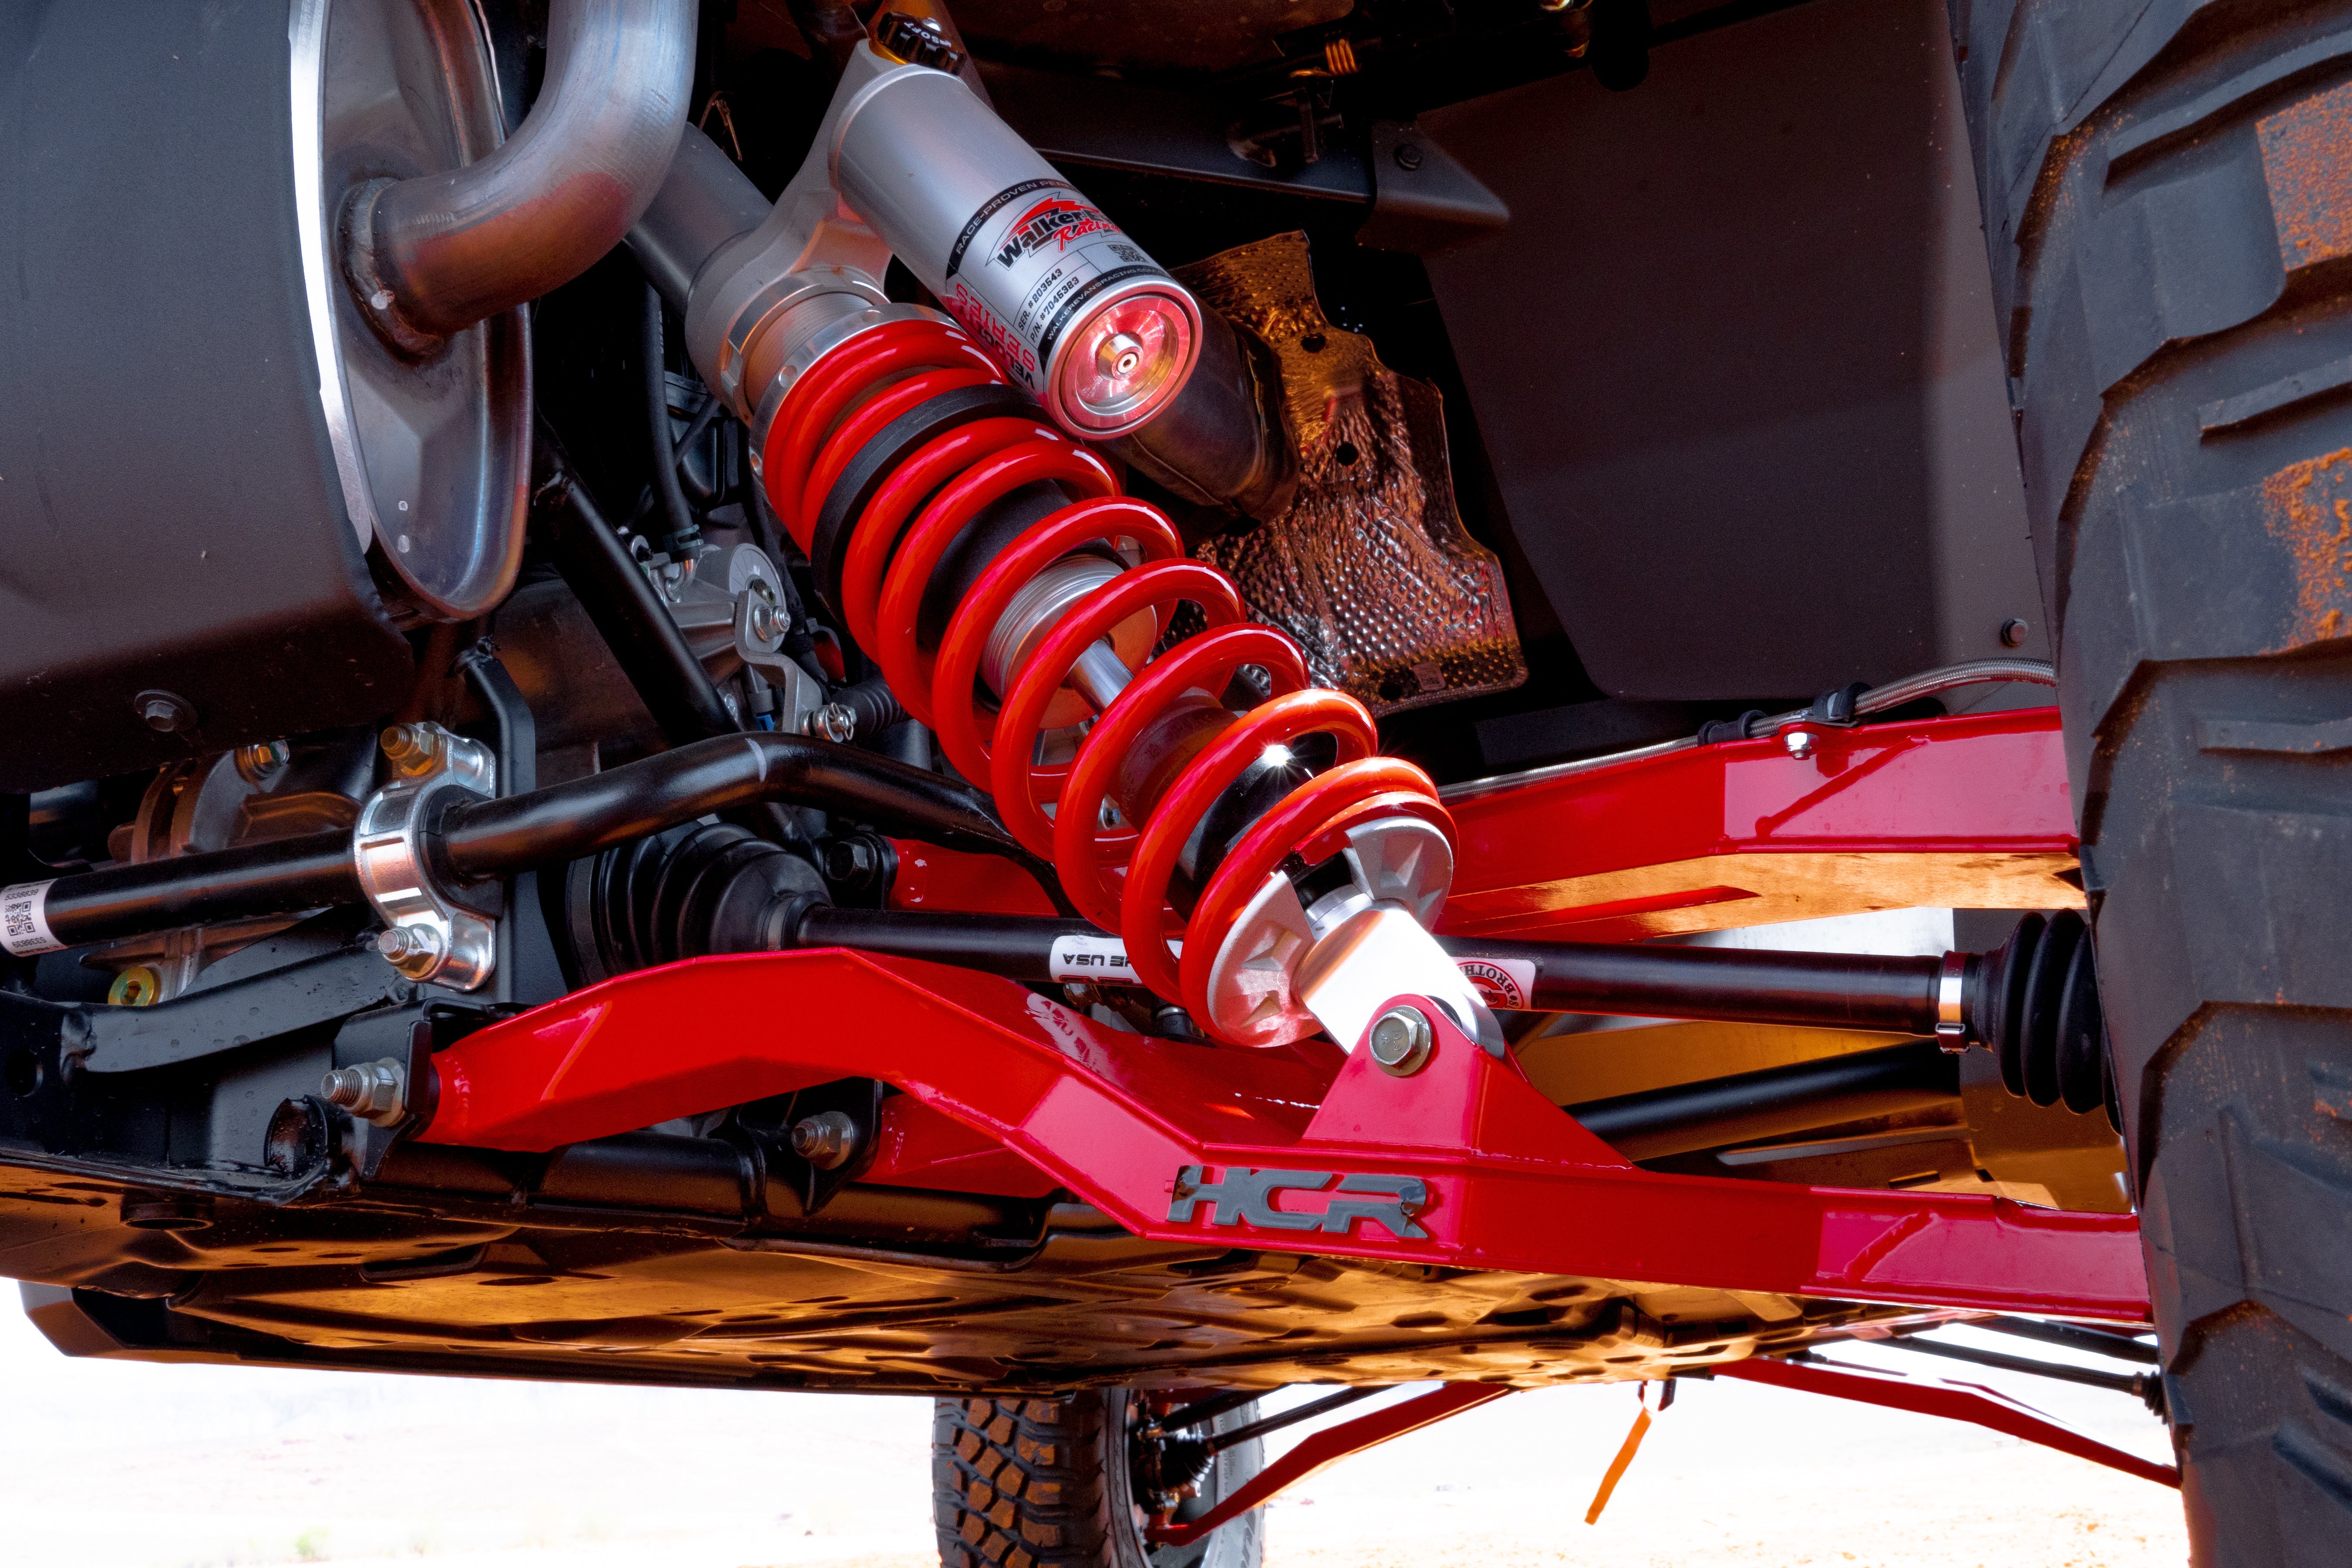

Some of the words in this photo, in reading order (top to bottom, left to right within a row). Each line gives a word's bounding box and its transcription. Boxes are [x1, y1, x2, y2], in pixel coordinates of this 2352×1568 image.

[904, 22, 940, 44] SOFT
[956, 182, 1037, 254] RACE-PROVEN
[1053, 218, 1121, 252] Racing
[956, 283, 1035, 372] SERIES
[1018, 310, 1031, 331] SER.
[1030, 322, 1043, 342] P/N.
[13, 937, 47, 947] 5338839
[1062, 953, 1105, 967] USA
[1460, 964, 1516, 995] BROTH
[1167, 1165, 1428, 1239] HCR
